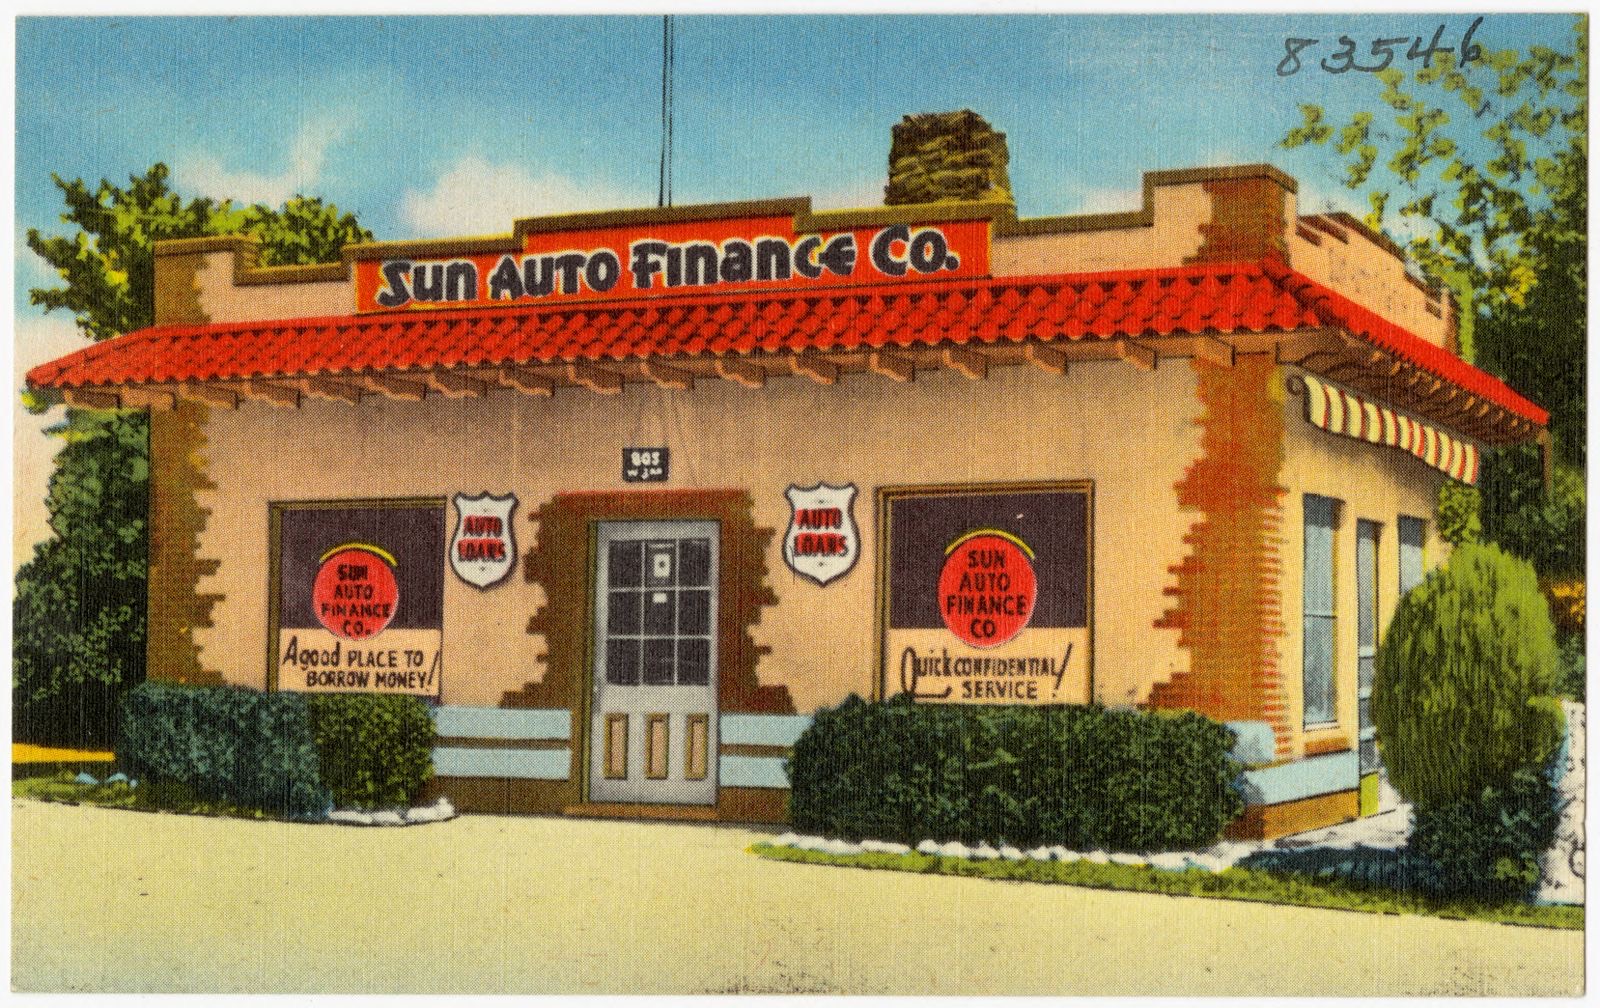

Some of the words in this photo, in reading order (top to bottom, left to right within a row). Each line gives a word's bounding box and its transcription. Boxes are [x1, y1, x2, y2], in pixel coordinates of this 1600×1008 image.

[1276, 16, 1483, 77] 83546
[869, 223, 961, 277] Co.
[463, 515, 503, 537] AUTO
[796, 507, 843, 529] AUTO
[458, 538, 506, 562] LOANS
[794, 532, 848, 556] LOANS
[966, 549, 1006, 569] SUN
[336, 564, 368, 582] SUN
[958, 571, 1011, 593] AUTO
[333, 584, 375, 600] AUTO
[321, 602, 391, 618] FINANCE
[945, 594, 1028, 617] FINANCE
[342, 620, 372, 636] CO.
[969, 617, 997, 639] CO
[347, 650, 397, 668] PLACE
[403, 649, 425, 667] TO
[306, 670, 369, 688] BORROW
